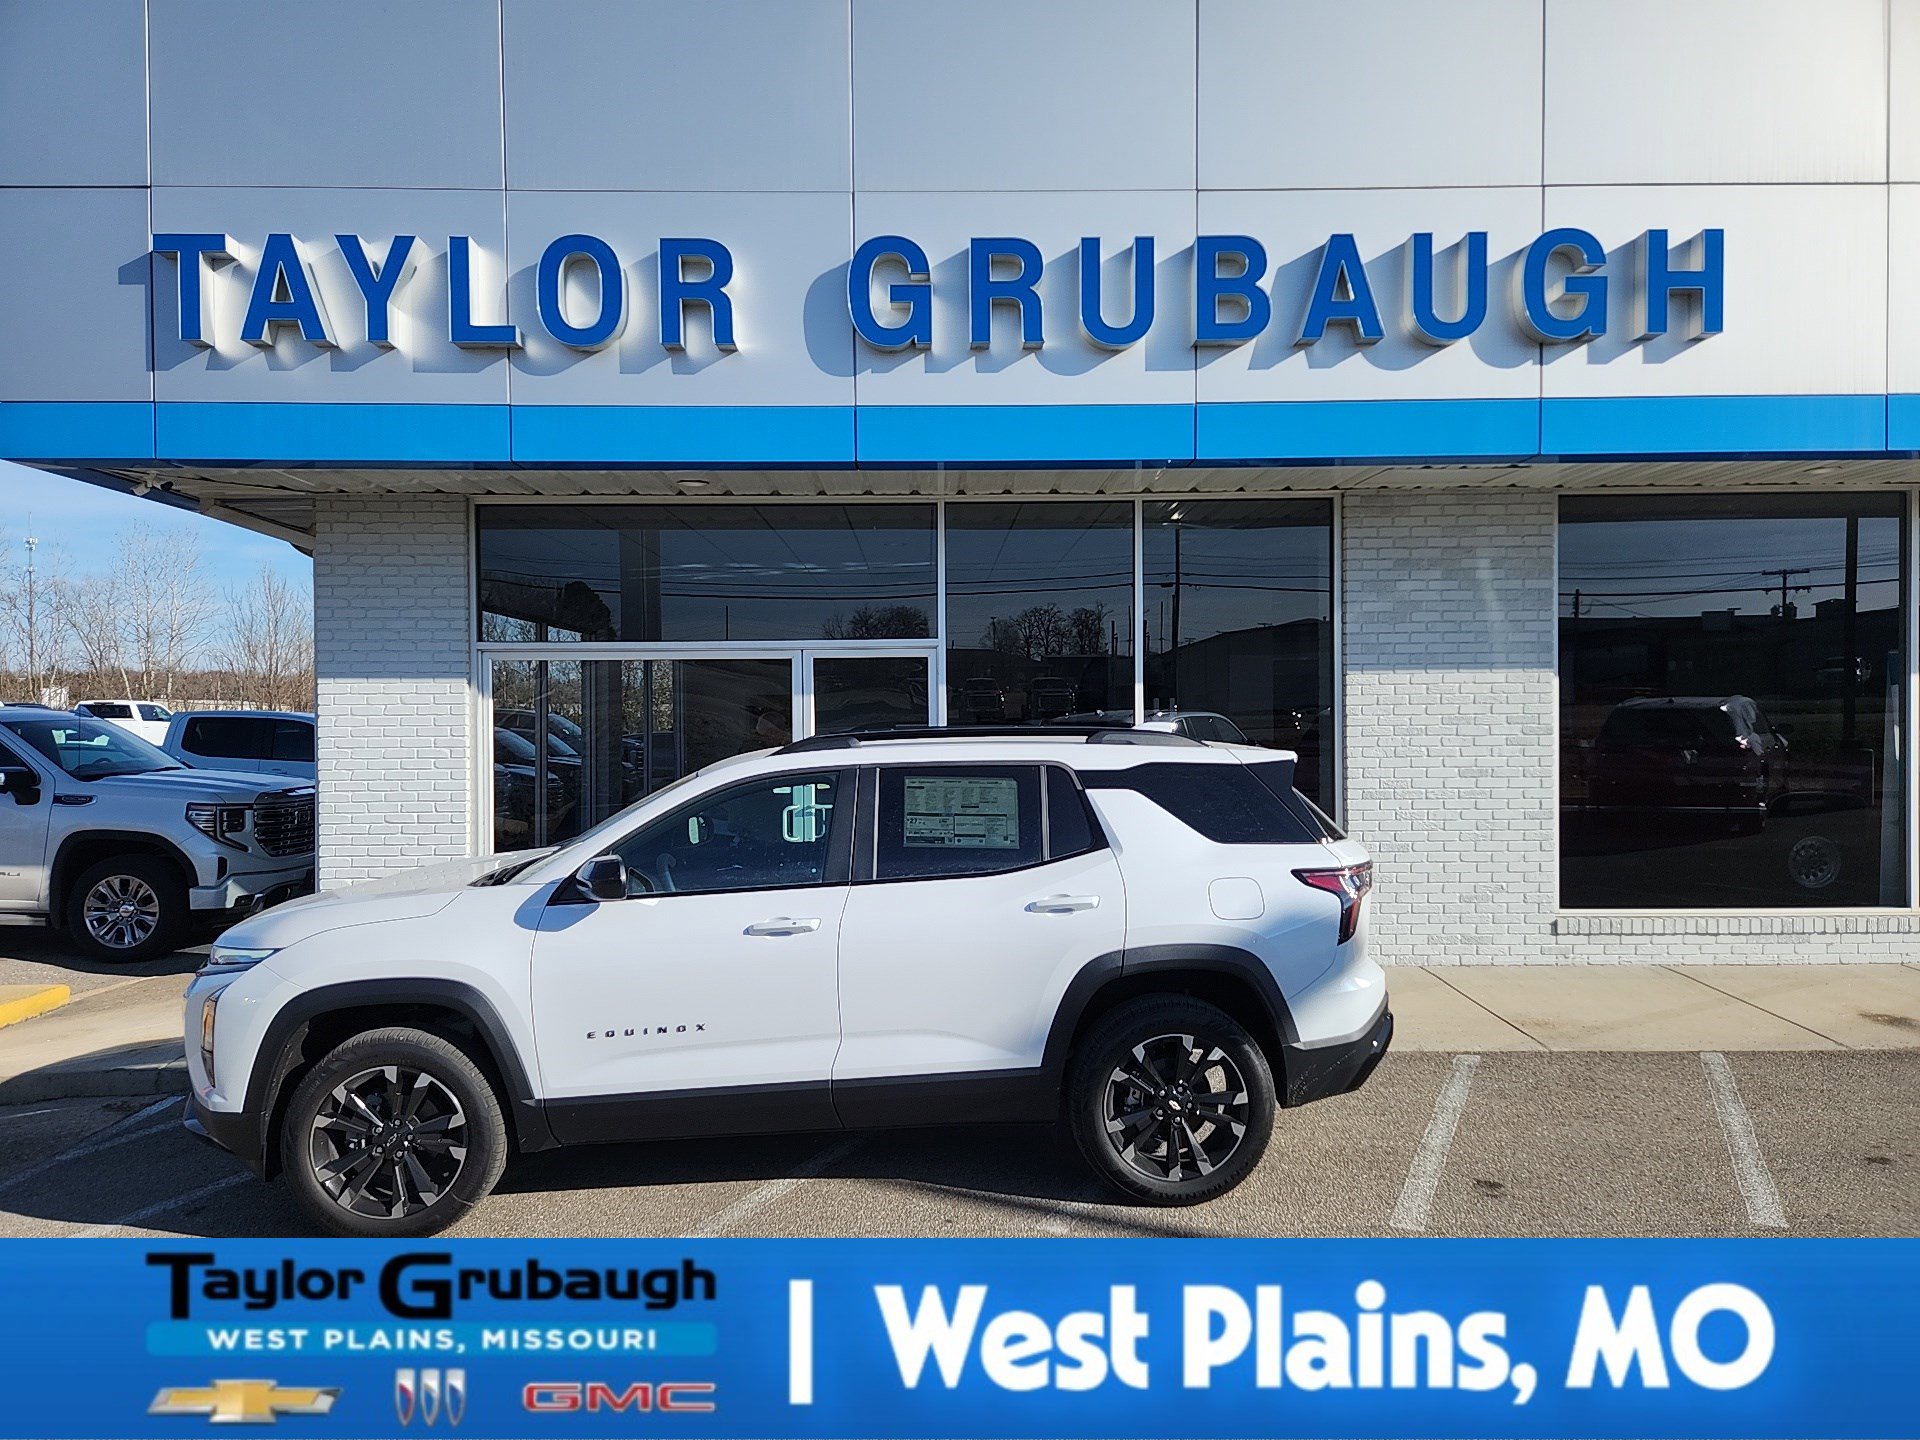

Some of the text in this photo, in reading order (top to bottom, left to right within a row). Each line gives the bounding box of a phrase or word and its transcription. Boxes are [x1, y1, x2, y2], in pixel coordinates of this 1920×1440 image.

[153, 228, 1724, 350] TAYLOR GRUBAUGH
[586, 1023, 706, 1039] EQUINOX
